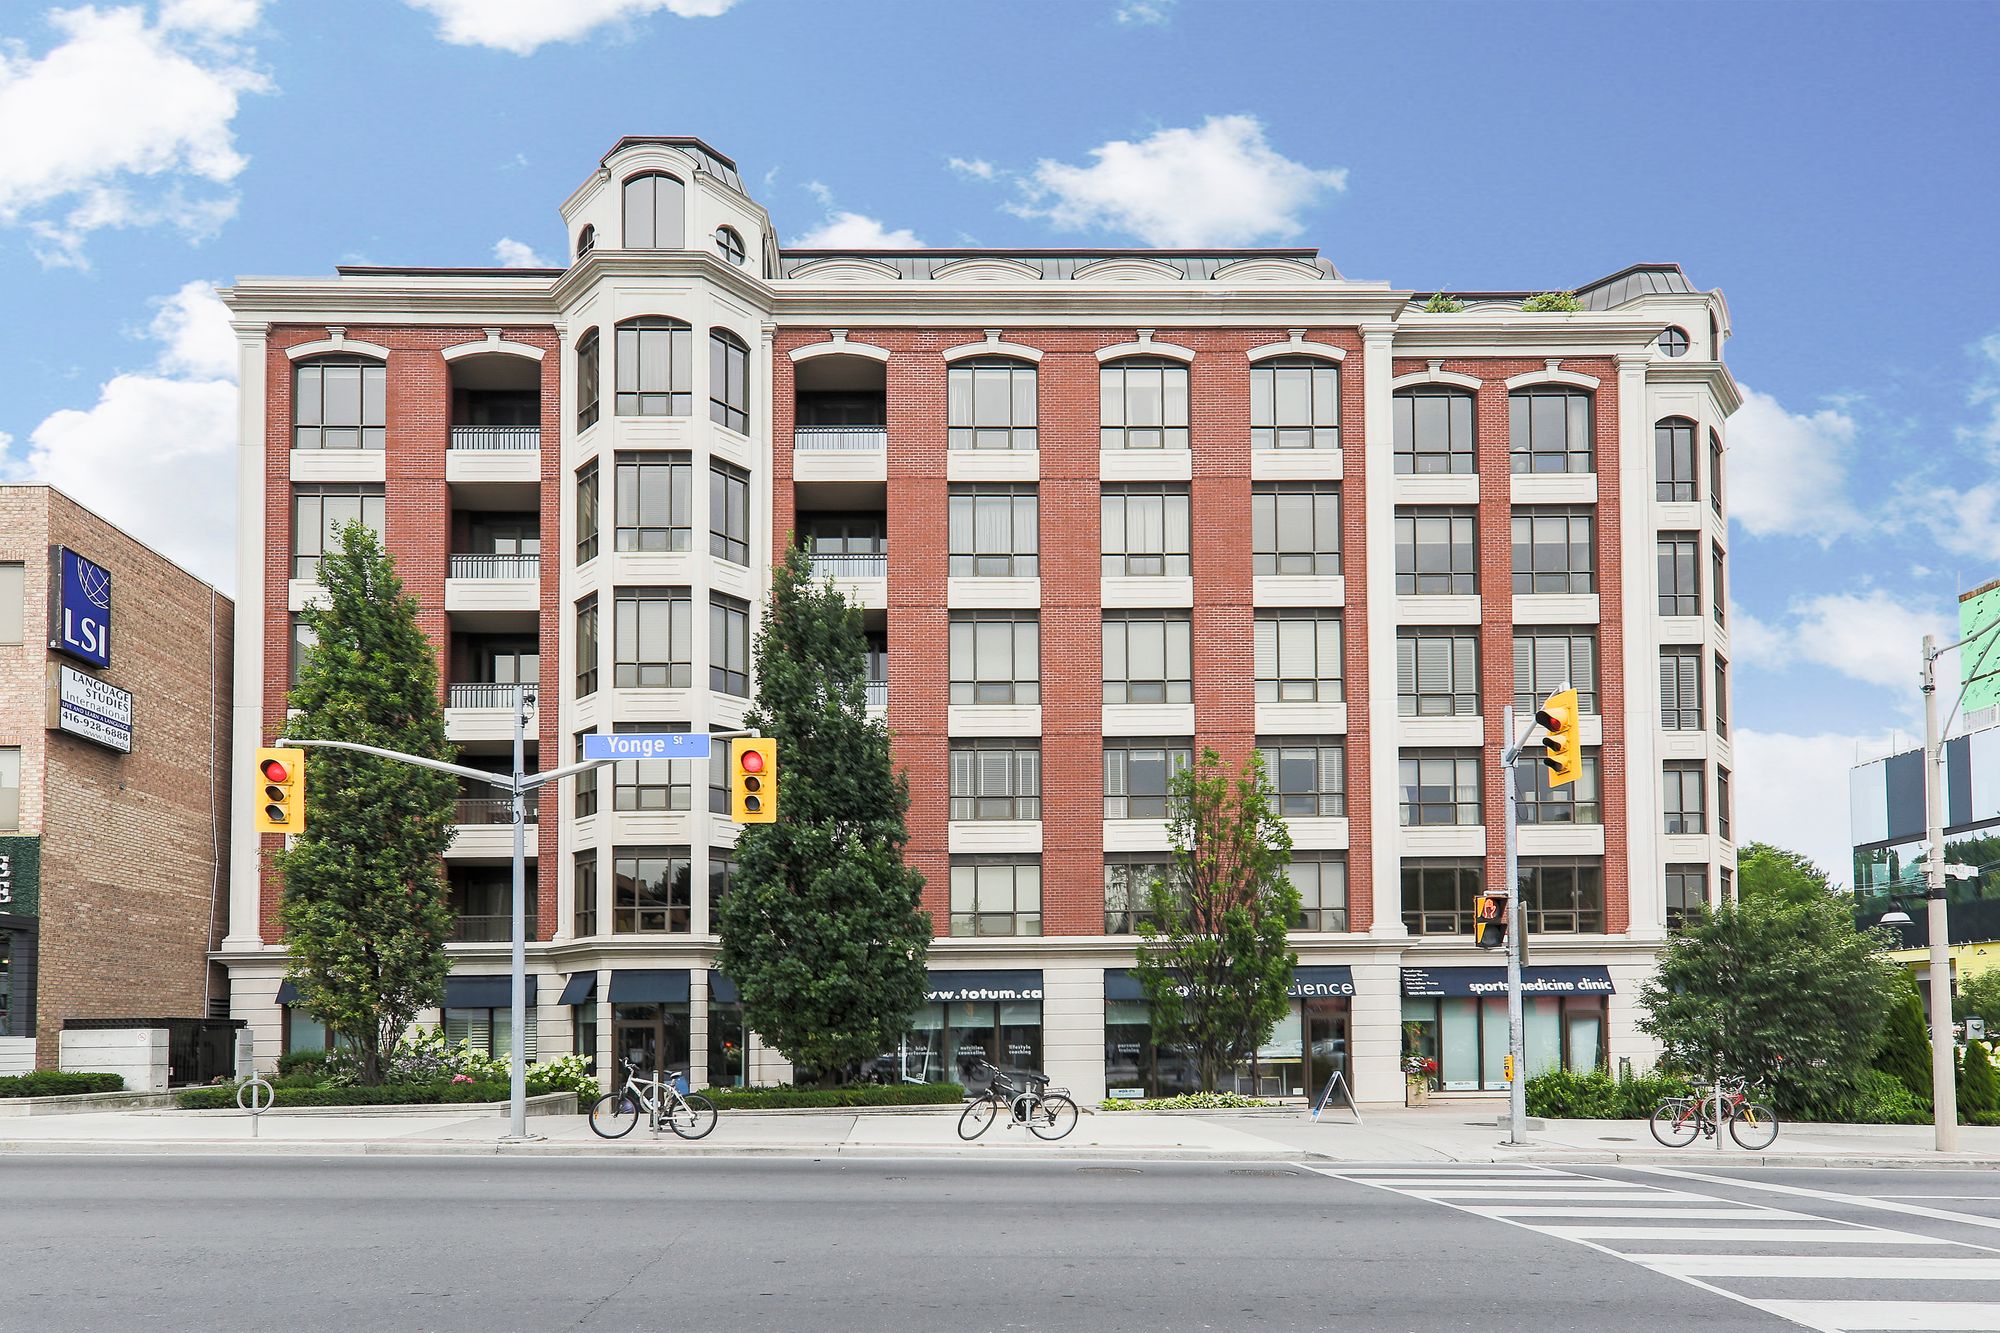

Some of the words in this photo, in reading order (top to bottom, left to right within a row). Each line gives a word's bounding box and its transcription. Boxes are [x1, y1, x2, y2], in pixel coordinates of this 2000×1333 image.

[64, 607, 106, 658] LSI
[72, 671, 130, 703] LANGUAGE
[66, 690, 129, 722] International
[72, 706, 85, 714] AND
[85, 688, 129, 713] STUDIES
[62, 711, 129, 742] 416-928-6888
[83, 729, 129, 749] www.LSI.edu
[607, 736, 665, 757] Yonge
[672, 735, 683, 745] St
[922, 988, 1043, 1000] ww.totum.ca
[1285, 978, 1353, 996] cience
[1468, 981, 1509, 994] sports
[1577, 977, 1613, 990] clinic
